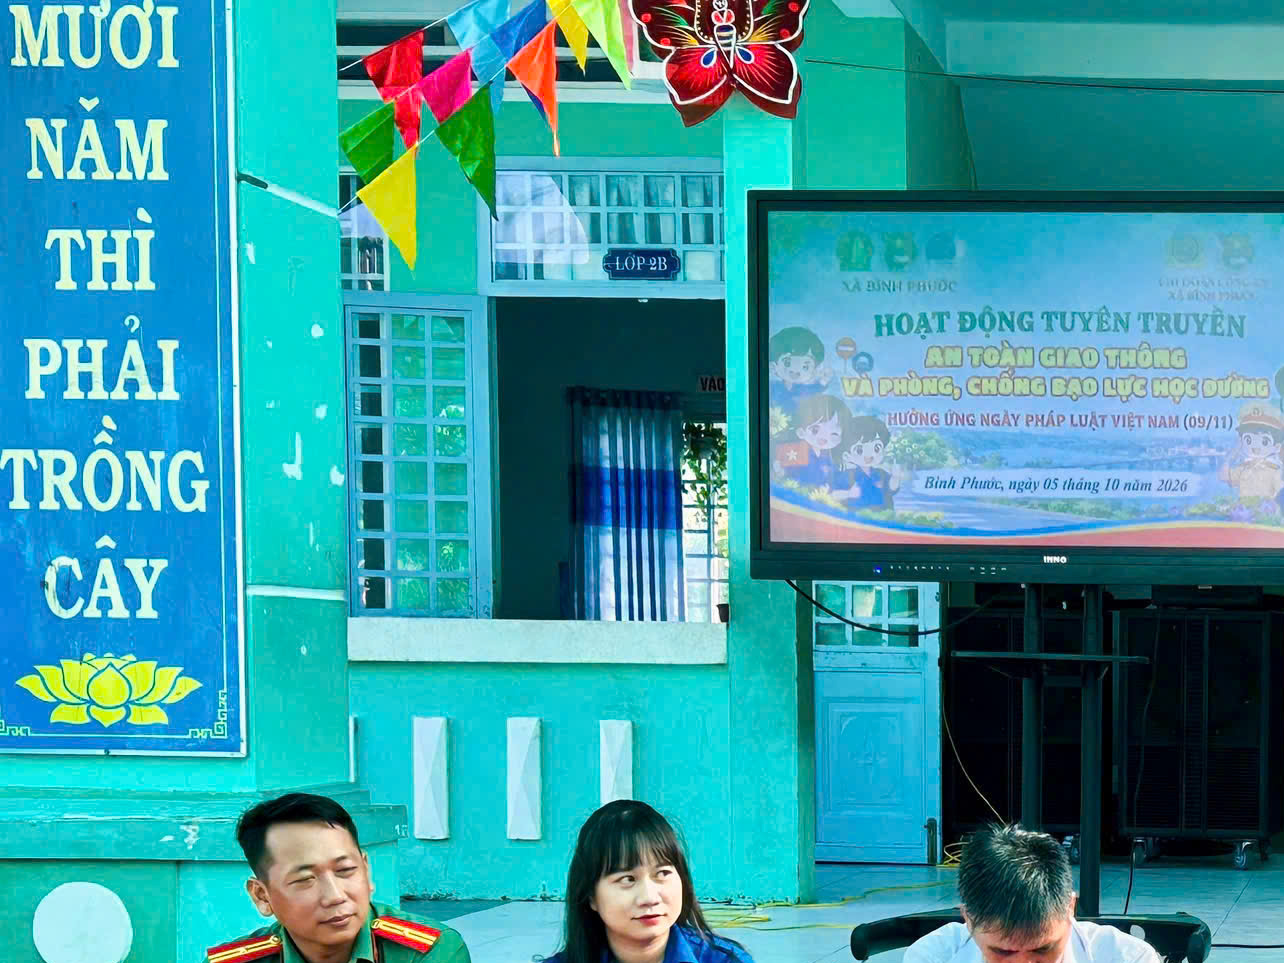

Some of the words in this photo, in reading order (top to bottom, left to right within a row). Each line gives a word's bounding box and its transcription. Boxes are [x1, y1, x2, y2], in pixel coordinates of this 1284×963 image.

[26, 97, 169, 182] NĂM
[44, 207, 157, 291] THÌ
[616, 252, 645, 271] LỚP
[650, 257, 668, 271] 2B
[874, 311, 950, 340] HOẠT
[957, 305, 1034, 339] ĐỘNG
[1041, 305, 1131, 334] TUYÊN
[1137, 305, 1247, 339] TRUYỀN
[23, 315, 180, 401] PHẢI
[924, 345, 963, 369] AN
[968, 339, 1034, 369] TOÀN
[1038, 346, 1100, 369] GIAO
[1103, 341, 1188, 369] THÔNG
[841, 370, 874, 397] VÀ
[878, 369, 962, 401] PHÒNG,
[966, 366, 1046, 397] CHỐNG
[1050, 376, 1098, 401] BẠO
[1102, 374, 1148, 403] LỰC
[1151, 376, 1199, 404] HỌC
[945, 409, 976, 427] ỨNG
[980, 410, 1020, 427] NGÀY
[1025, 410, 1066, 427] PHÁP
[1070, 412, 1106, 431] LUẬT
[1111, 412, 1145, 431] VIỆT
[1148, 415, 1180, 429] NAM
[1183, 415, 1233, 431] (09/11)
[0, 416, 210, 513] TRỒNG
[924, 476, 956, 490] Bình
[960, 476, 1004, 492] Phước,
[1008, 478, 1040, 493] ngày
[1043, 478, 1059, 490] 05
[1062, 477, 1100, 494] tháng
[1104, 478, 1120, 491] 10
[1123, 479, 1152, 492] năm
[1157, 479, 1188, 492] 2026
[44, 536, 169, 619] CÂY
